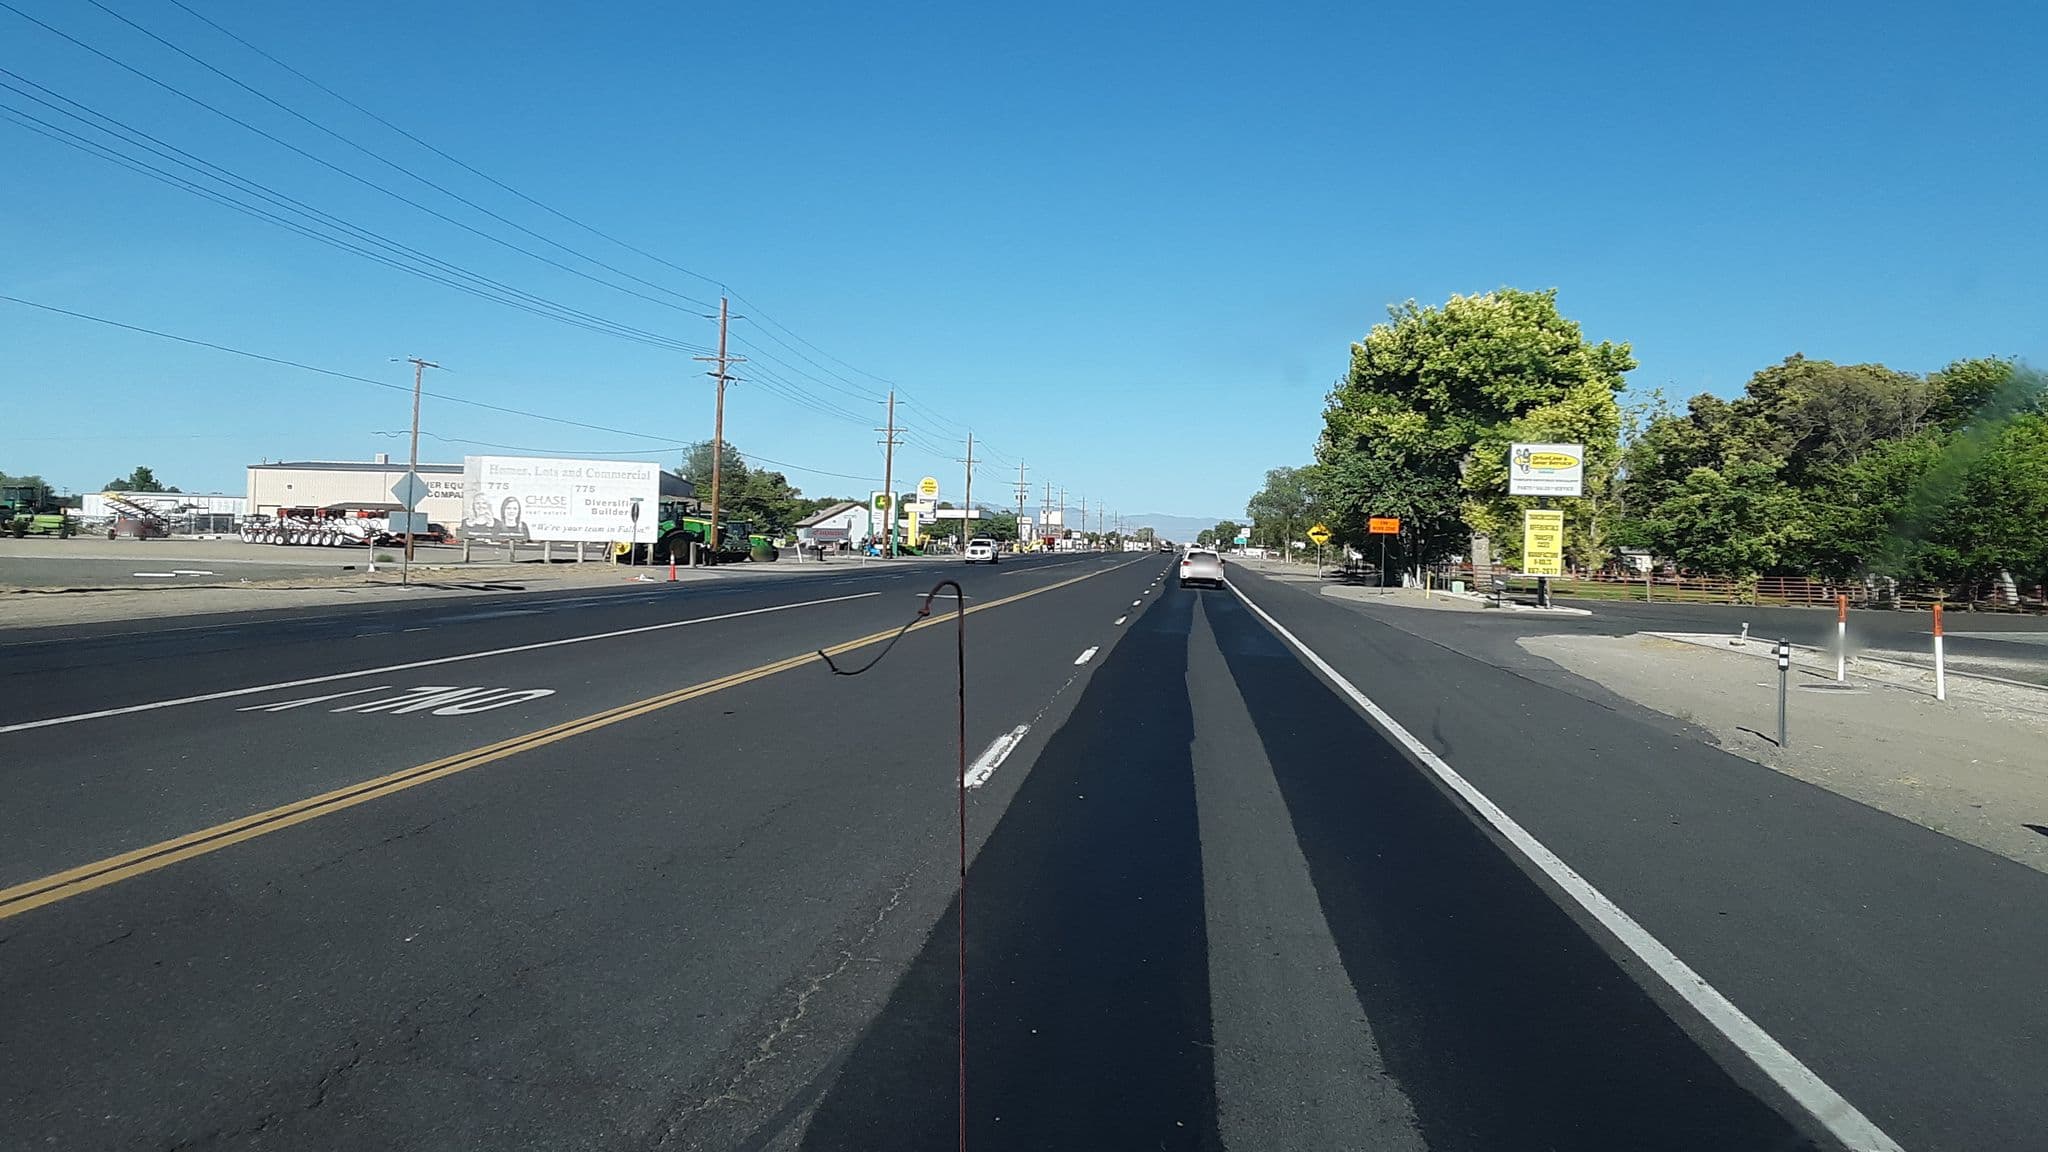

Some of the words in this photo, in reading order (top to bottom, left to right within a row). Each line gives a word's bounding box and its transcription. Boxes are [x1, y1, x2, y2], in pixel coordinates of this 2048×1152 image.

[534, 466, 559, 477] Lots
[562, 467, 582, 478] and
[585, 468, 651, 480] Commercial
[444, 481, 464, 490] EQU
[487, 481, 510, 490] 775
[575, 485, 596, 493] 775
[525, 495, 567, 505] CHASE
[585, 498, 632, 507] Diversifi
[591, 507, 629, 516] Builder
[236, 686, 556, 716] ONLY
